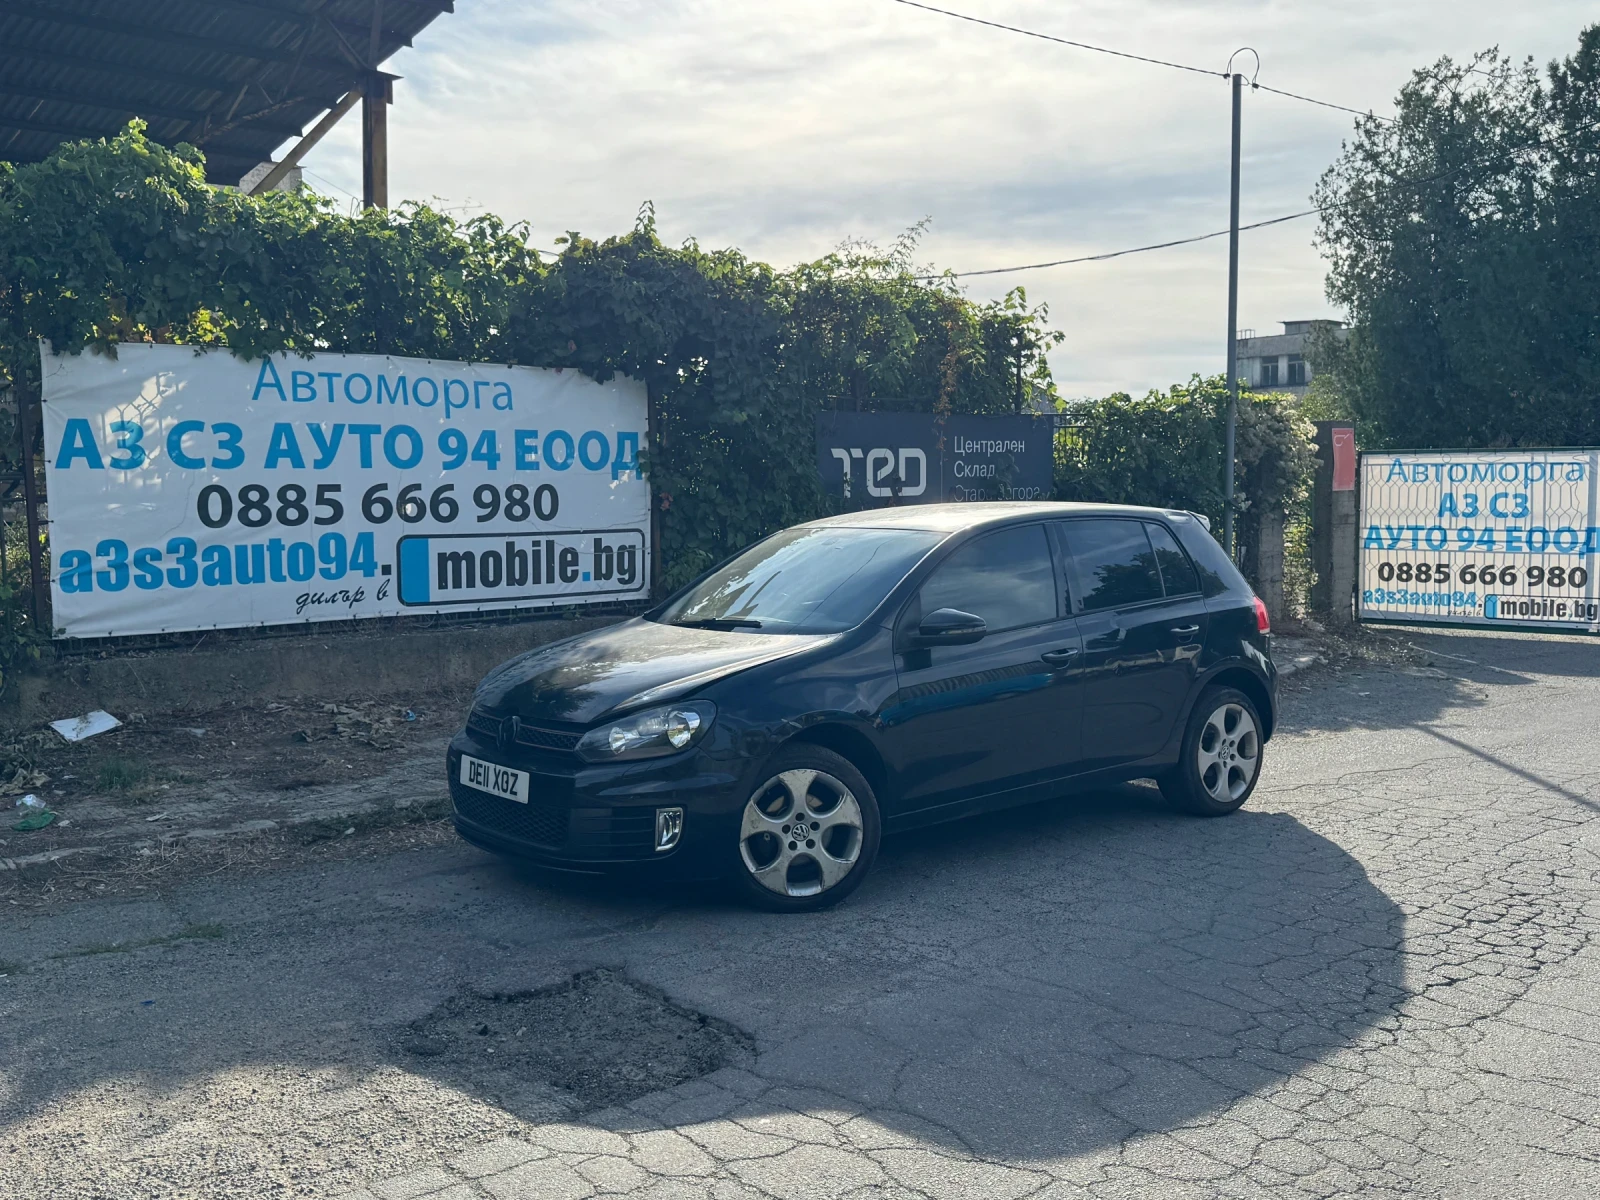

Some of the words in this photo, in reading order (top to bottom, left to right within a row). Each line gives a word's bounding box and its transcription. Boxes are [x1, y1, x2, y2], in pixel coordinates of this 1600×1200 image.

[252, 357, 514, 419] Автоморга
[264, 421, 424, 470] АУТО
[438, 427, 501, 471] 94
[515, 428, 642, 480] ЕООД
[954, 436, 1025, 457] Централен
[953, 461, 995, 479] Склад
[1386, 458, 1585, 489] Автоморга
[197, 483, 343, 528] 0885
[361, 482, 459, 524] 666
[473, 483, 559, 523] 980
[1364, 525, 1448, 551] АУТО
[1456, 526, 1496, 552] 94
[1505, 526, 1600, 560] ЕООД
[437, 536, 637, 591] mobile.bg
[1378, 562, 1450, 584] 0885
[1459, 563, 1518, 587] 666
[1526, 565, 1588, 588] 980
[296, 586, 366, 614] дилър
[377, 578, 390, 601] в
[1500, 597, 1598, 621] mobile.bg
